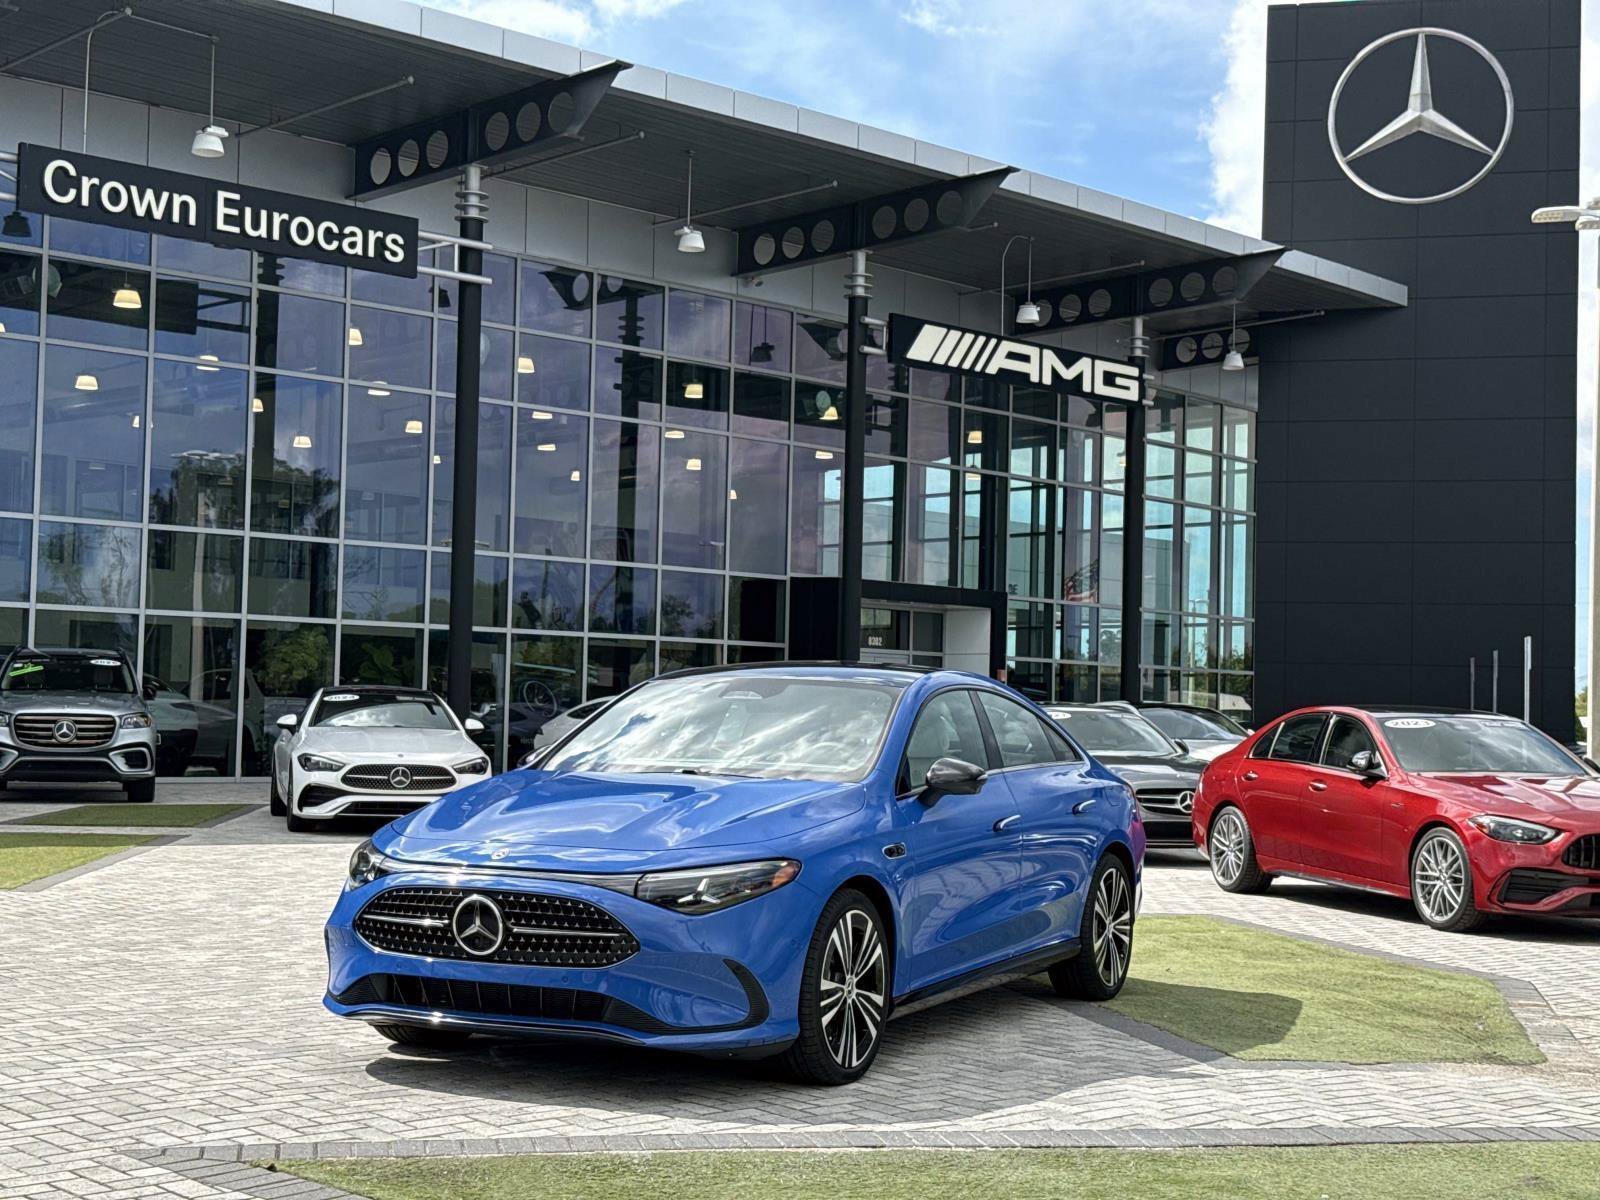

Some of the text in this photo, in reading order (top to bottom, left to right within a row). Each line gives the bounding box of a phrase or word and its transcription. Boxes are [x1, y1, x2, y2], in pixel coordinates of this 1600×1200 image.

[43, 159, 405, 263] Crown Eurocars
[985, 340, 1139, 401] AMG
